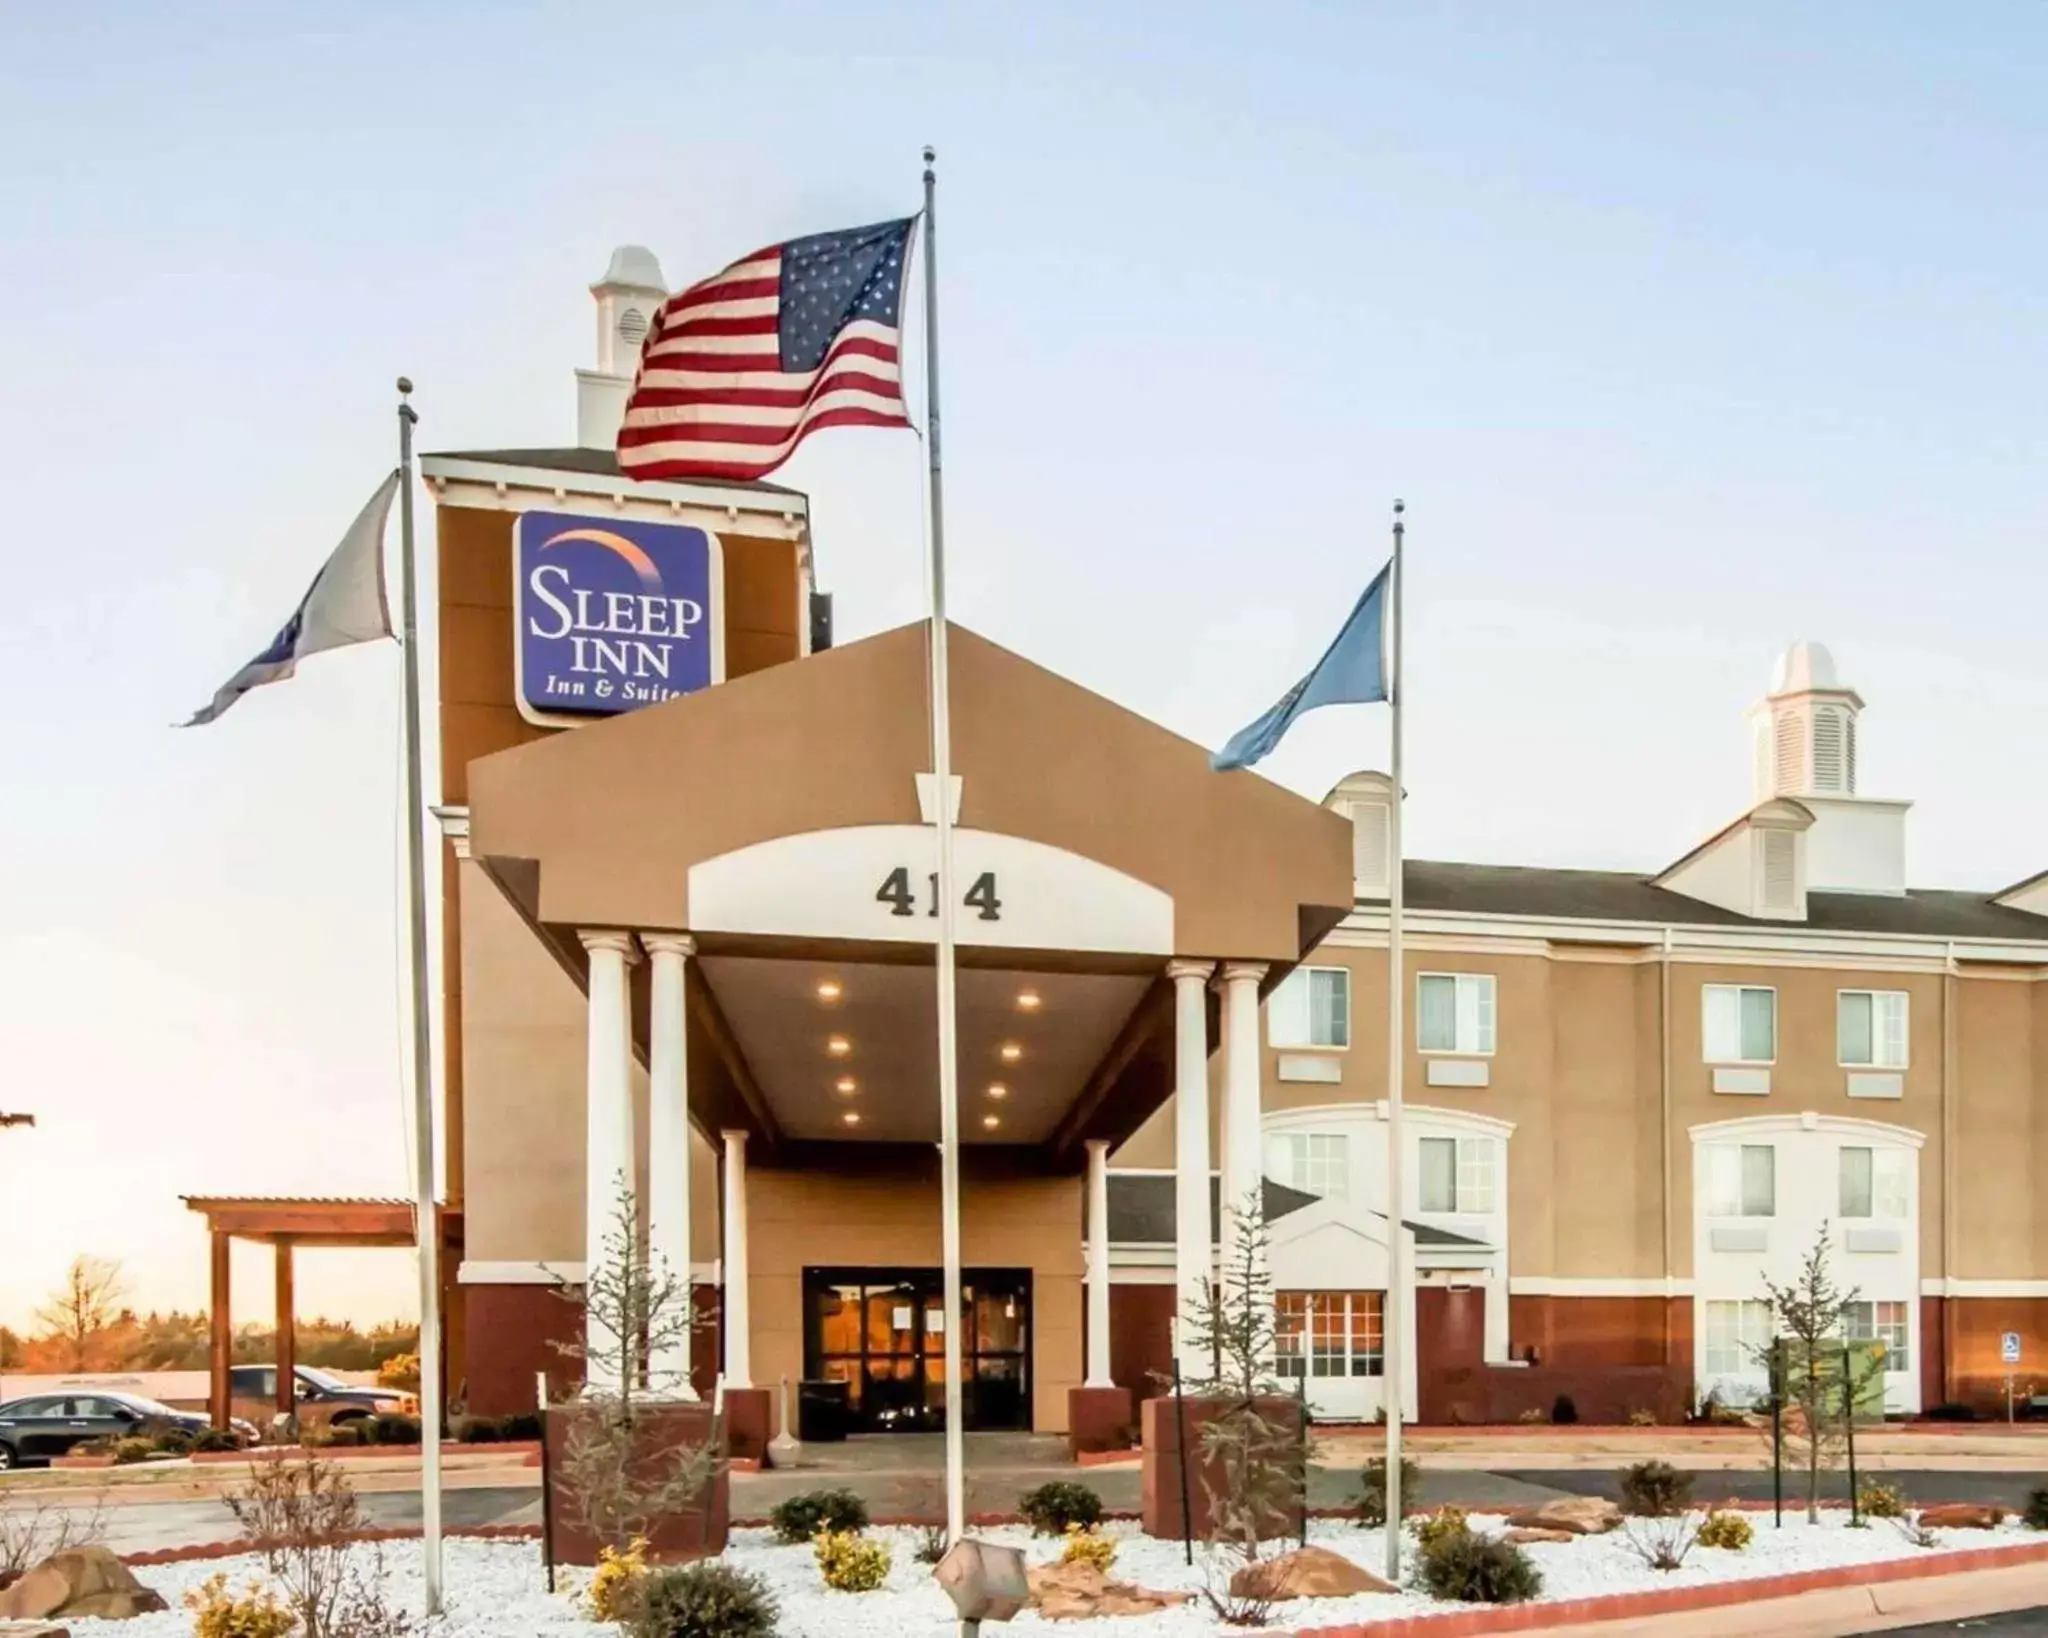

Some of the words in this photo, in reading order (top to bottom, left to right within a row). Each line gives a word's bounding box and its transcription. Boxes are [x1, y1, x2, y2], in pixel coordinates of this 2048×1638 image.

[530, 565, 702, 639] SLEEP
[570, 636, 673, 678] INN
[545, 675, 586, 696] Inn
[595, 679, 614, 698] &
[621, 681, 690, 702] Suite
